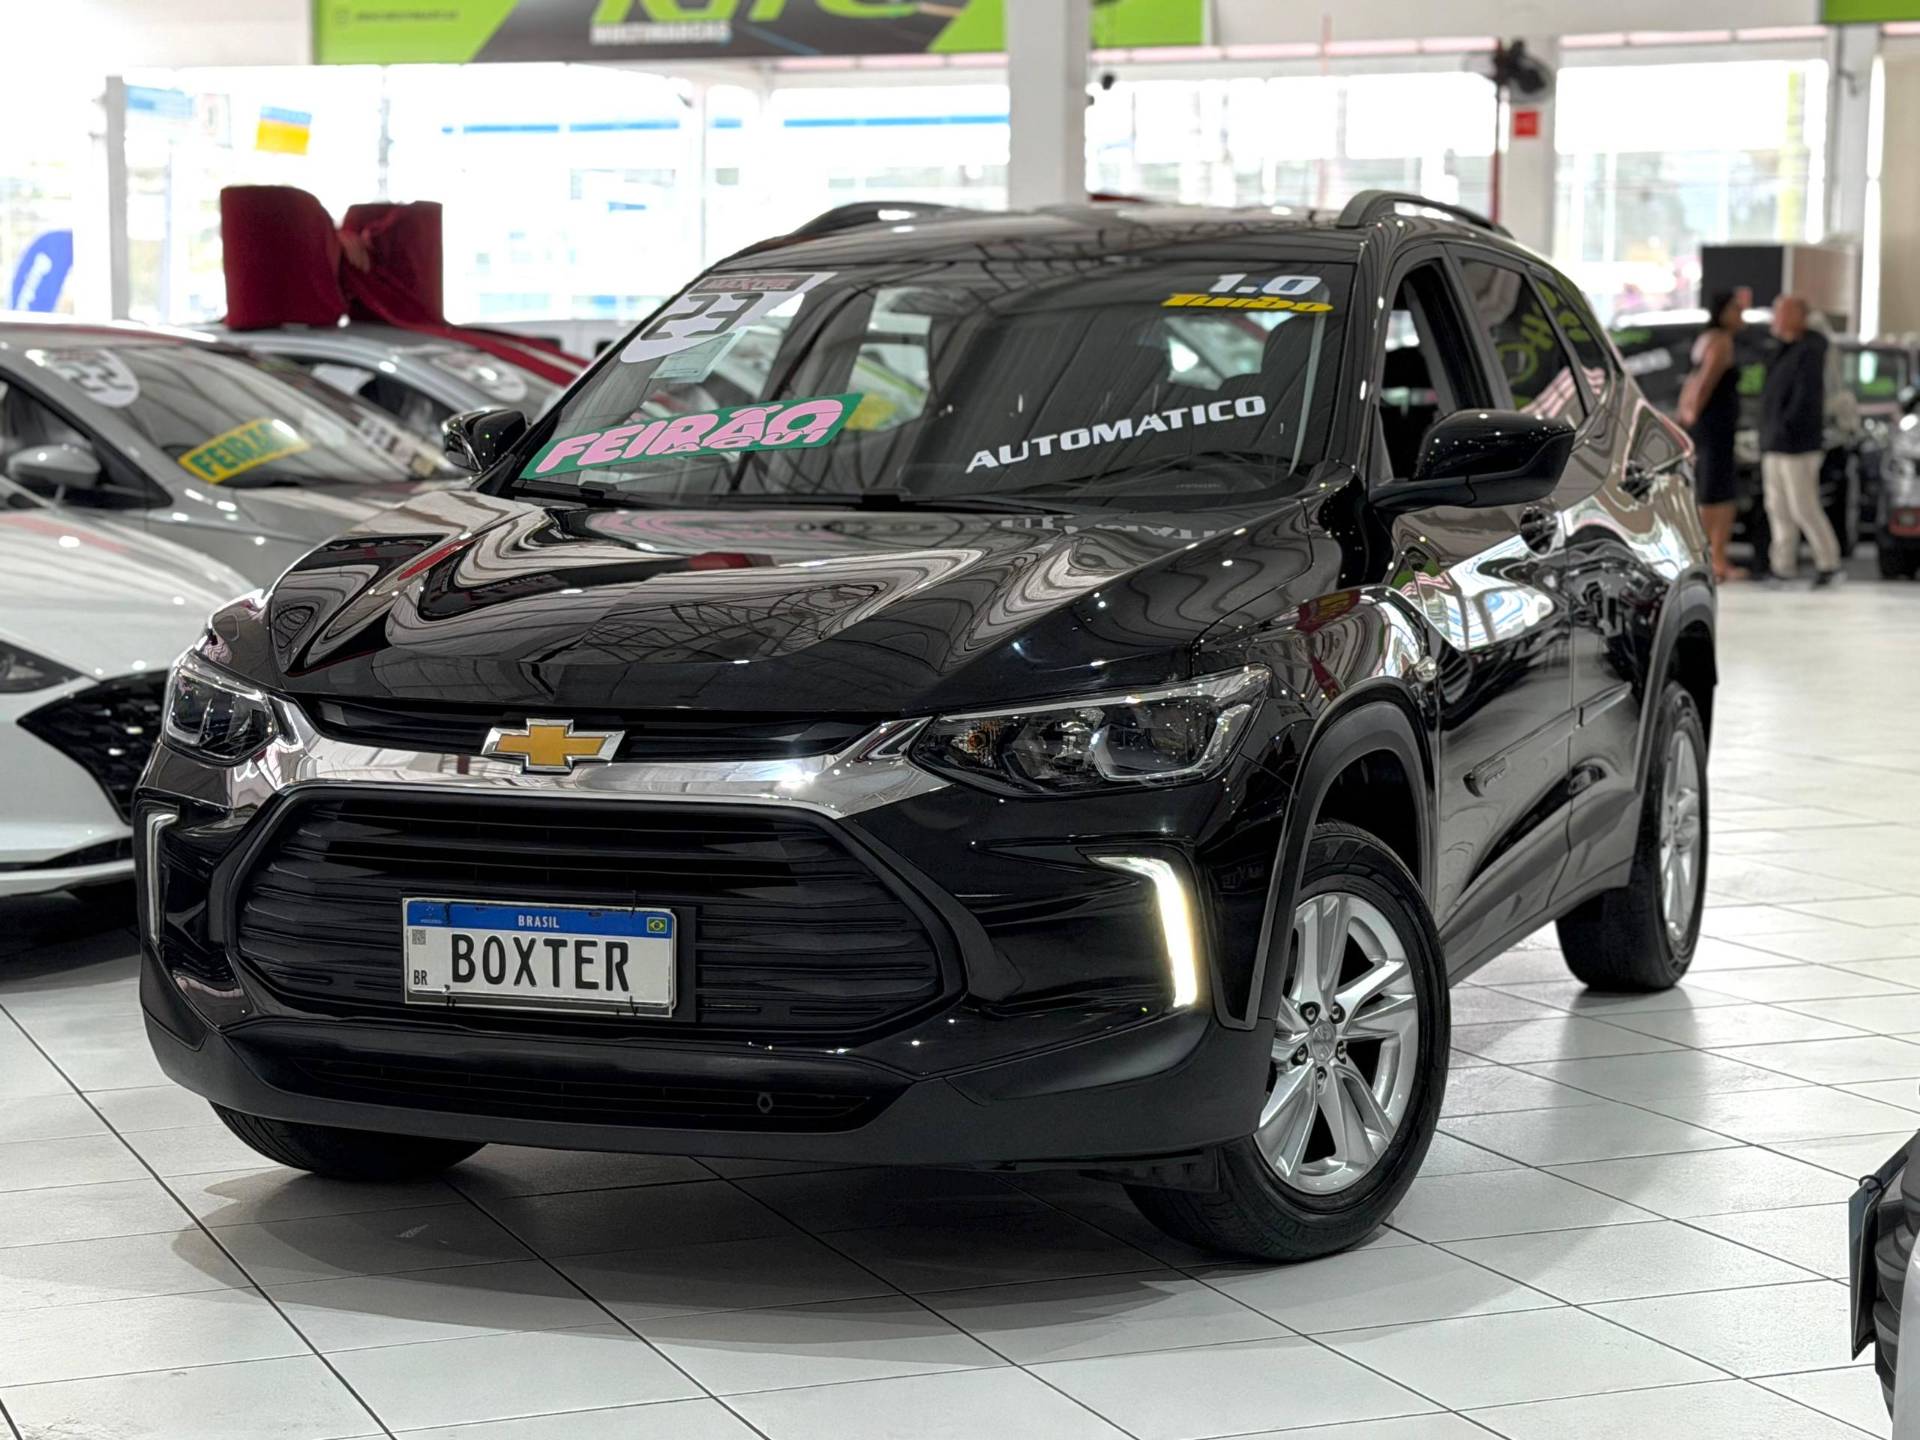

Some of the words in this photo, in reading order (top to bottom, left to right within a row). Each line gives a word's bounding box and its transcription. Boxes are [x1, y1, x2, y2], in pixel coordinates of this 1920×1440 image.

[1209, 273, 1322, 295] 1.0
[1162, 293, 1333, 312] Turbo
[640, 292, 764, 341] 23
[535, 399, 844, 473] FEIRÃO
[517, 914, 560, 928] BRASIL
[451, 933, 629, 992] BOXTER
[413, 969, 428, 986] BR
